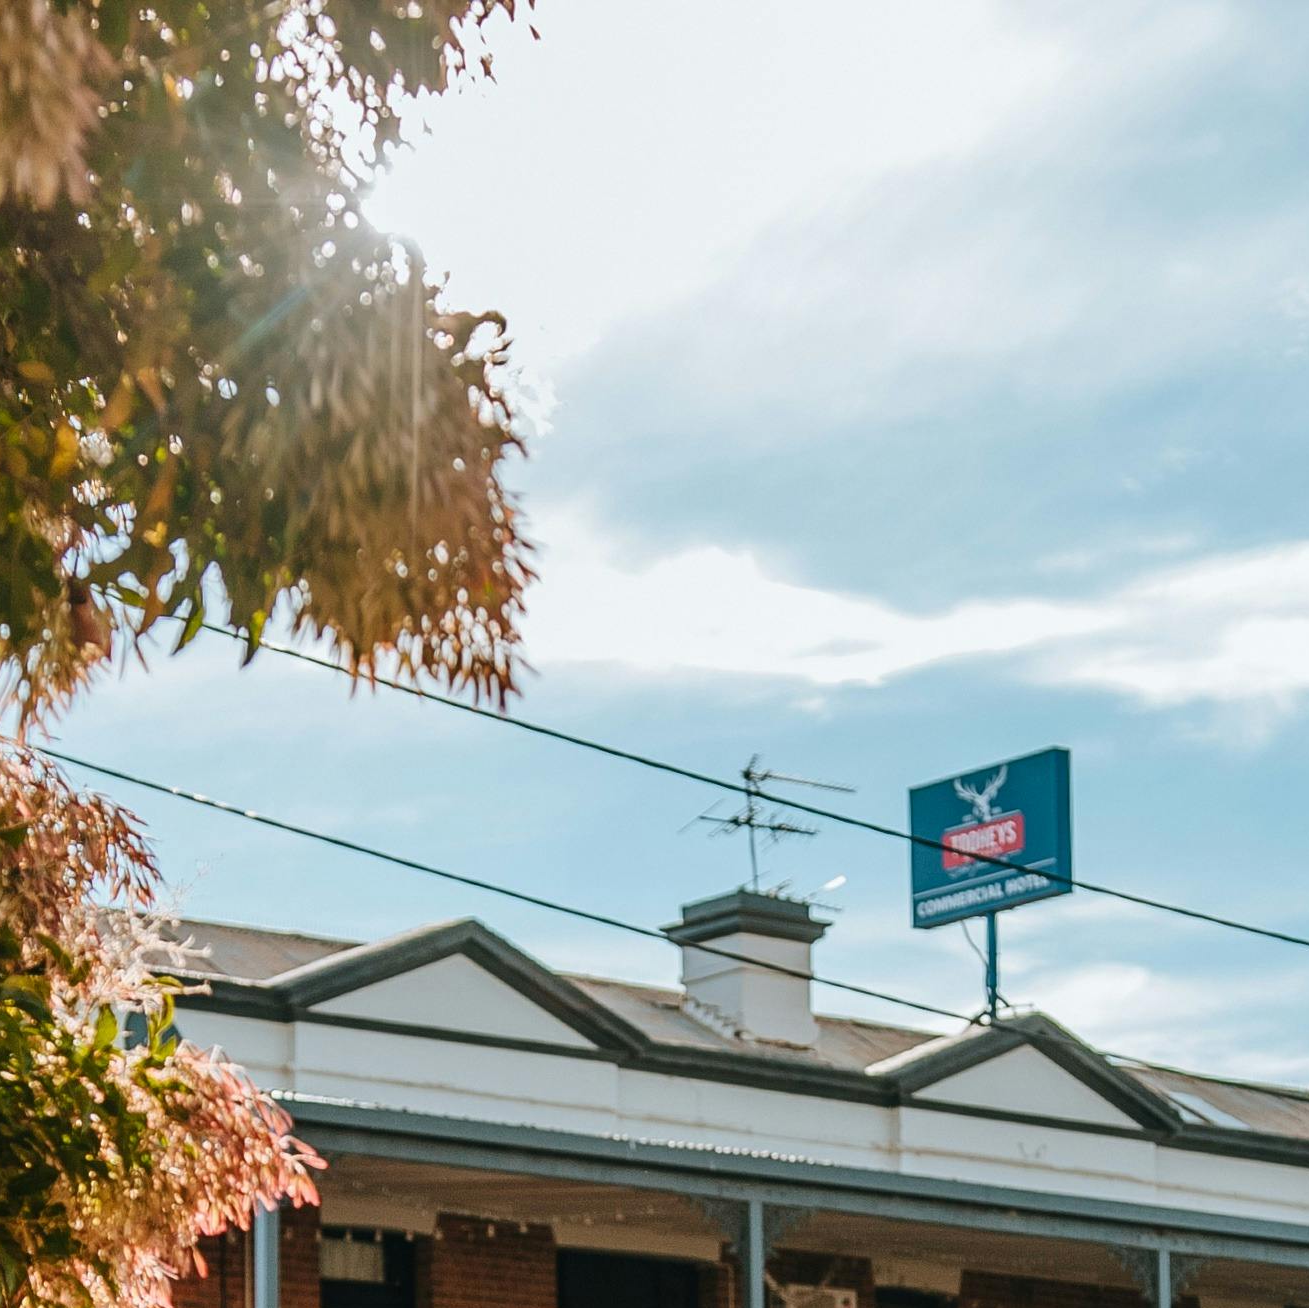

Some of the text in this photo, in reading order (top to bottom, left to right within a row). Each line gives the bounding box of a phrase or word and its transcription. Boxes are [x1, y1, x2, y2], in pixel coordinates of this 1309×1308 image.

[950, 819, 1018, 857] TOOHEYS
[916, 873, 1051, 918] COMMERCIAL HOTEL
